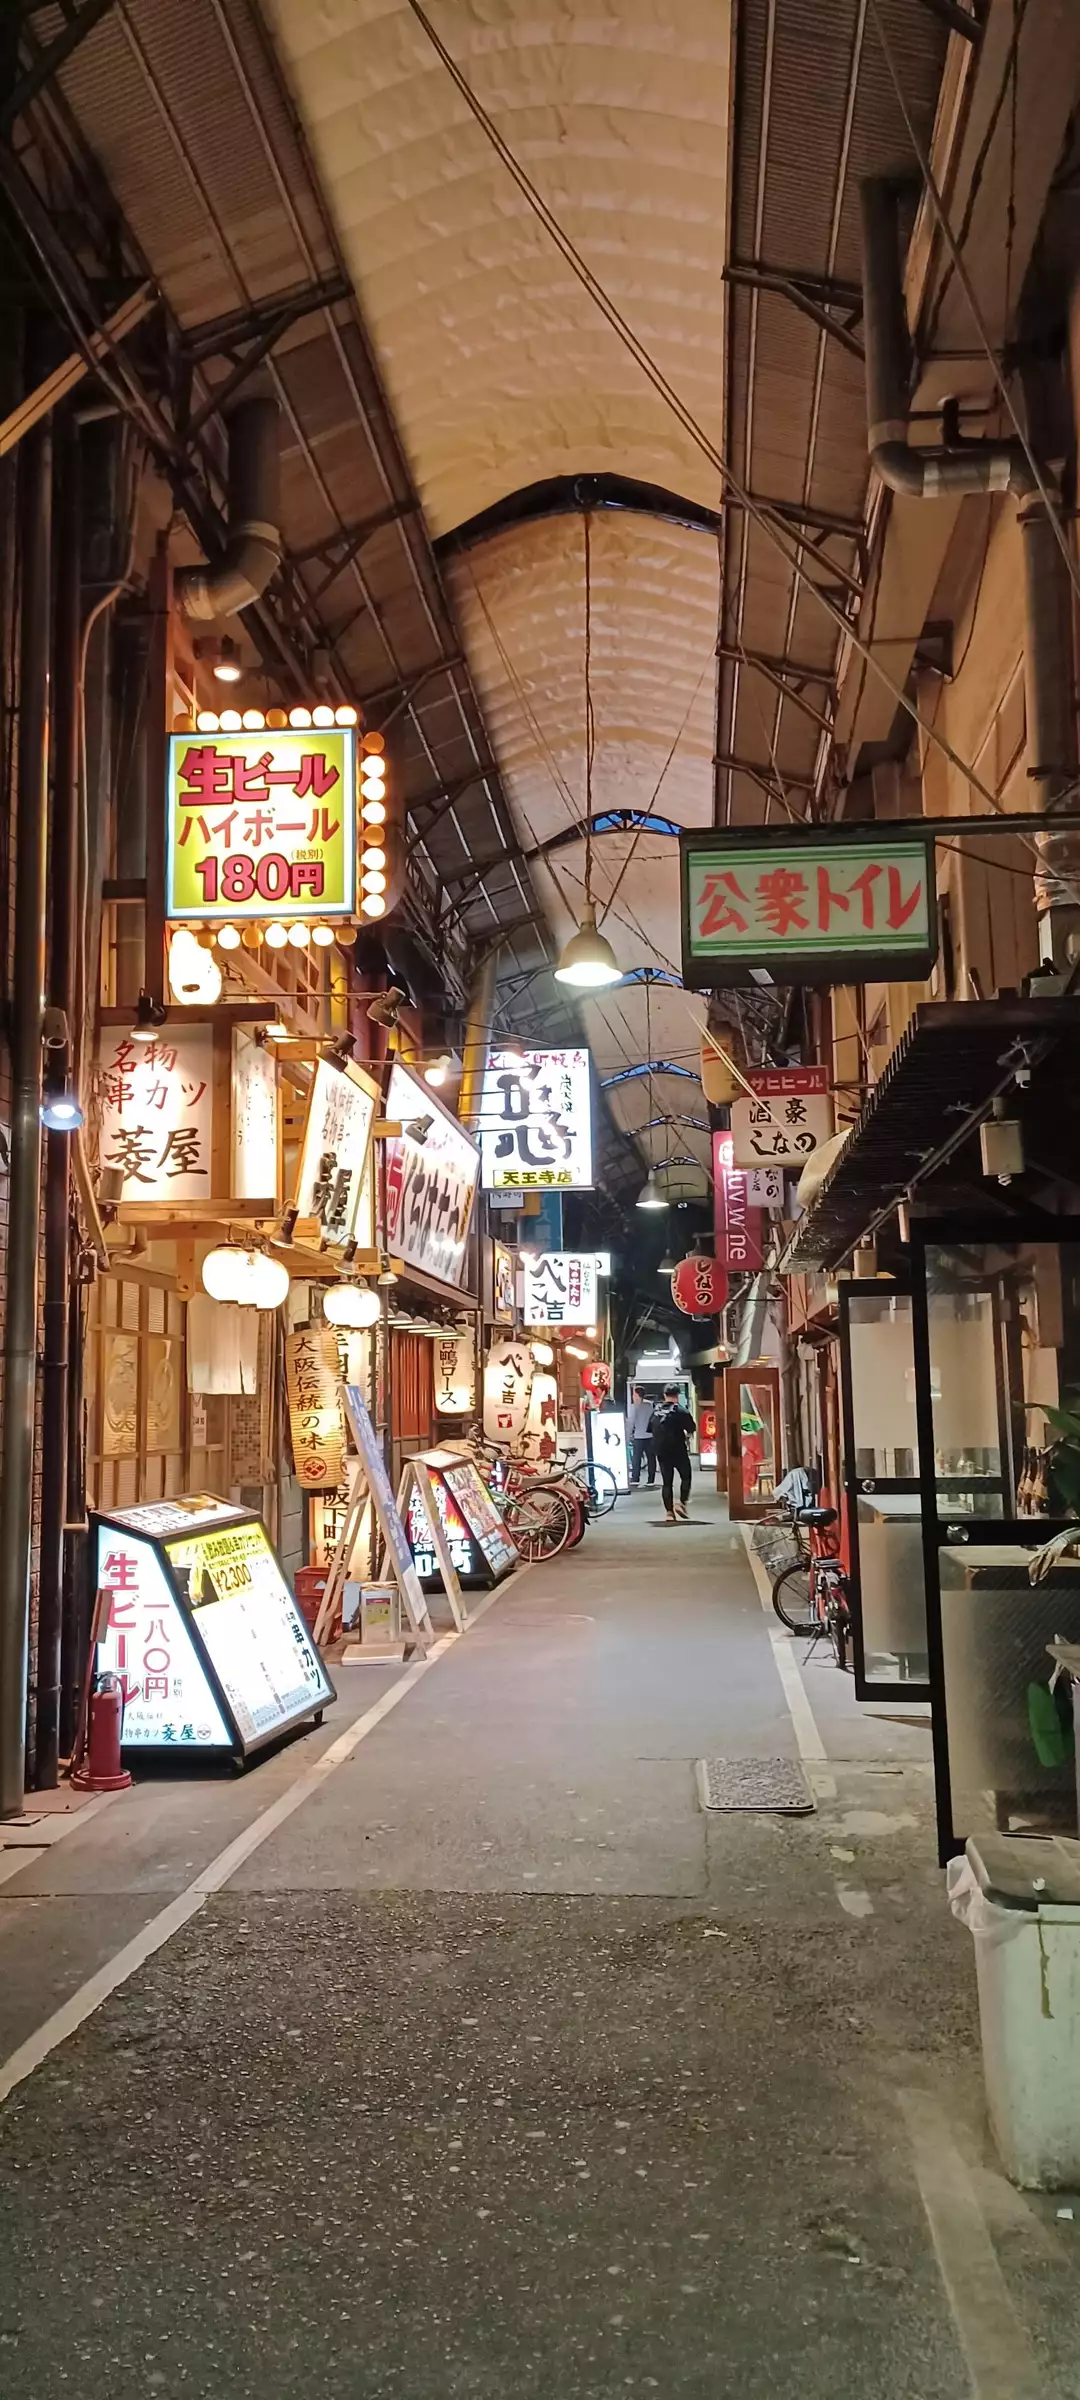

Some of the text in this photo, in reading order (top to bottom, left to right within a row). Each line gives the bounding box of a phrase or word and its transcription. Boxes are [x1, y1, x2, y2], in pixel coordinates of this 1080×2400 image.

[178, 745, 340, 806] 生ビール
[177, 807, 340, 849] ハイボール
[195, 853, 324, 902] 180円
[696, 863, 922, 938] 公衆トイレ
[109, 1040, 178, 1075] 名物
[107, 1079, 207, 1115] 串カツ
[749, 1097, 807, 1124] 酒豪
[104, 1125, 208, 1184] 菱屋
[750, 1129, 817, 1156] しなの
[503, 1169, 573, 1185] 天王寺店
[529, 1258, 568, 1320] べこ吉
[696, 1259, 714, 1305] しなの
[293, 1336, 326, 1451] 大阪伝統の味
[499, 1354, 524, 1405] べこ吉
[212, 1563, 253, 1593] ¥2,300
[103, 1553, 140, 1705] 生ビール
